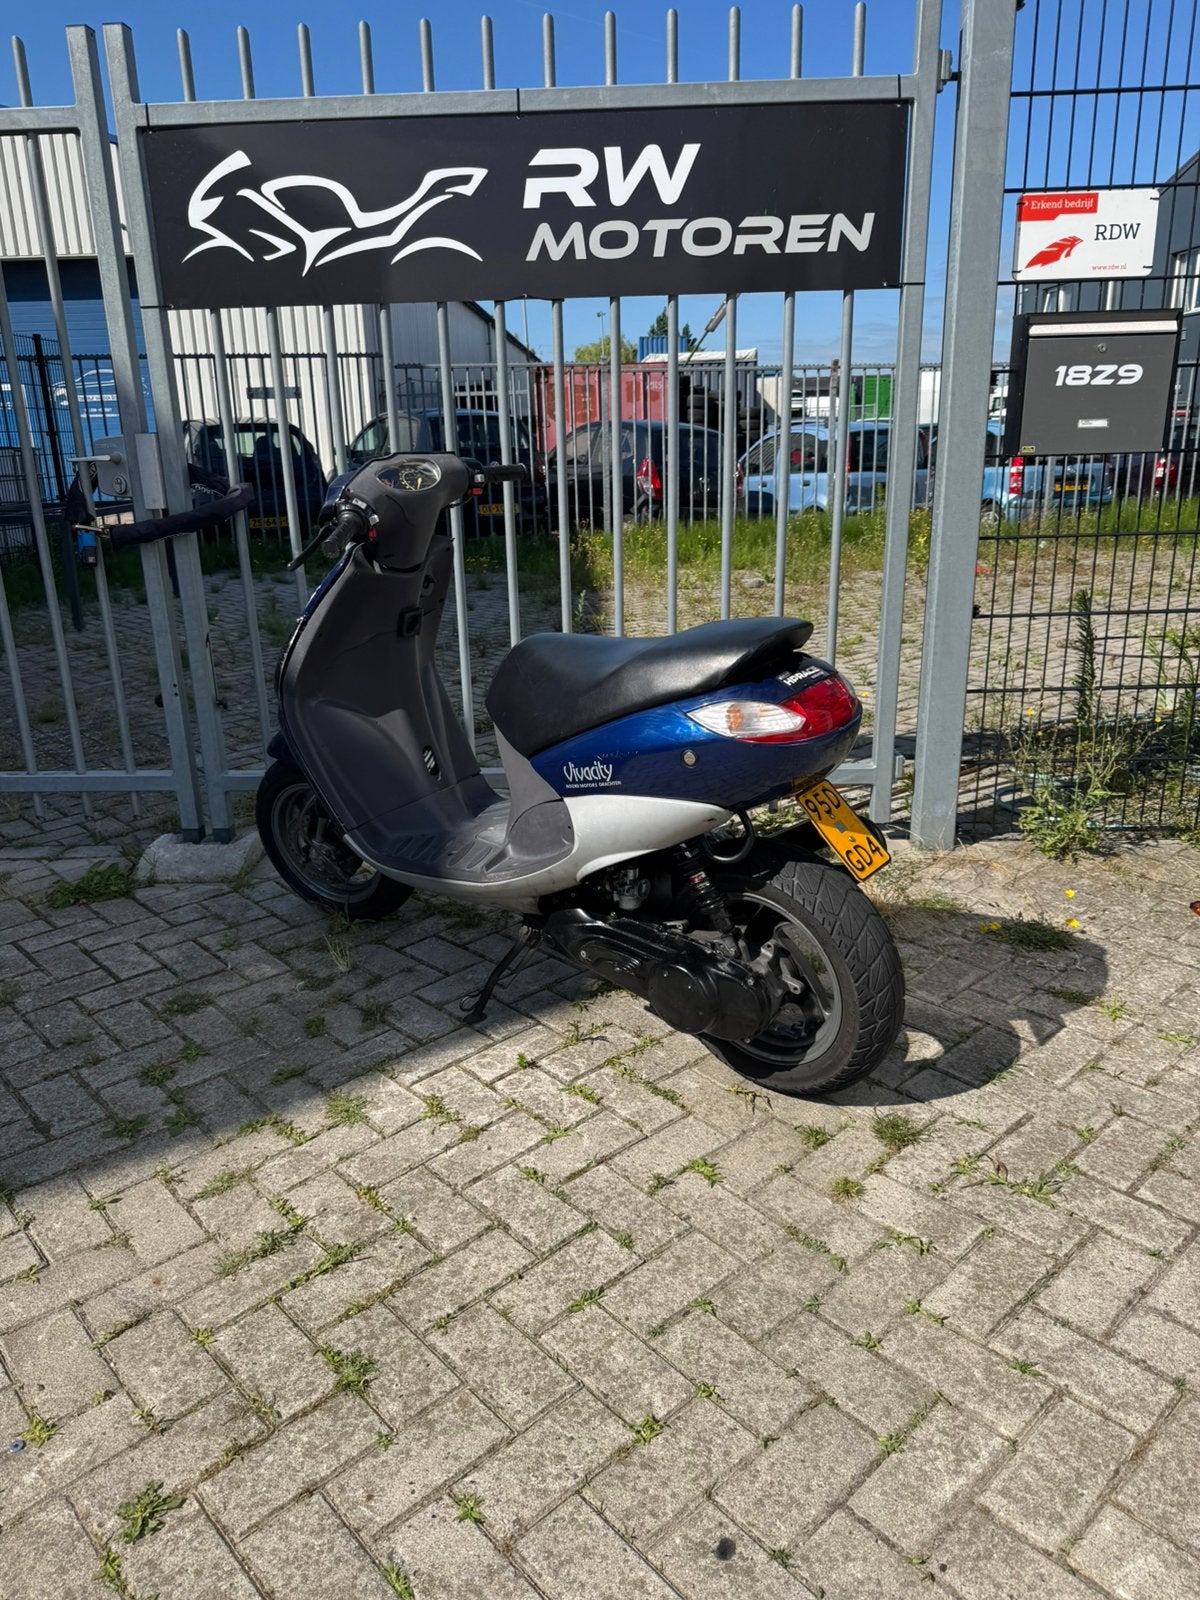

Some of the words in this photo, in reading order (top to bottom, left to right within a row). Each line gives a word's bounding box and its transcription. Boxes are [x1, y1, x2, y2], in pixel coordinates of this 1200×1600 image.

[522, 143, 701, 209] RW
[1031, 199, 1063, 210] Erkend
[1064, 198, 1094, 209] bedrijf
[525, 212, 875, 262] MOTOREN
[1094, 222, 1141, 241] RDW
[1055, 363, 1144, 387] 18Z9
[563, 760, 613, 782] Vivacity
[805, 788, 841, 821] 95D
[845, 836, 884, 872] GD4
